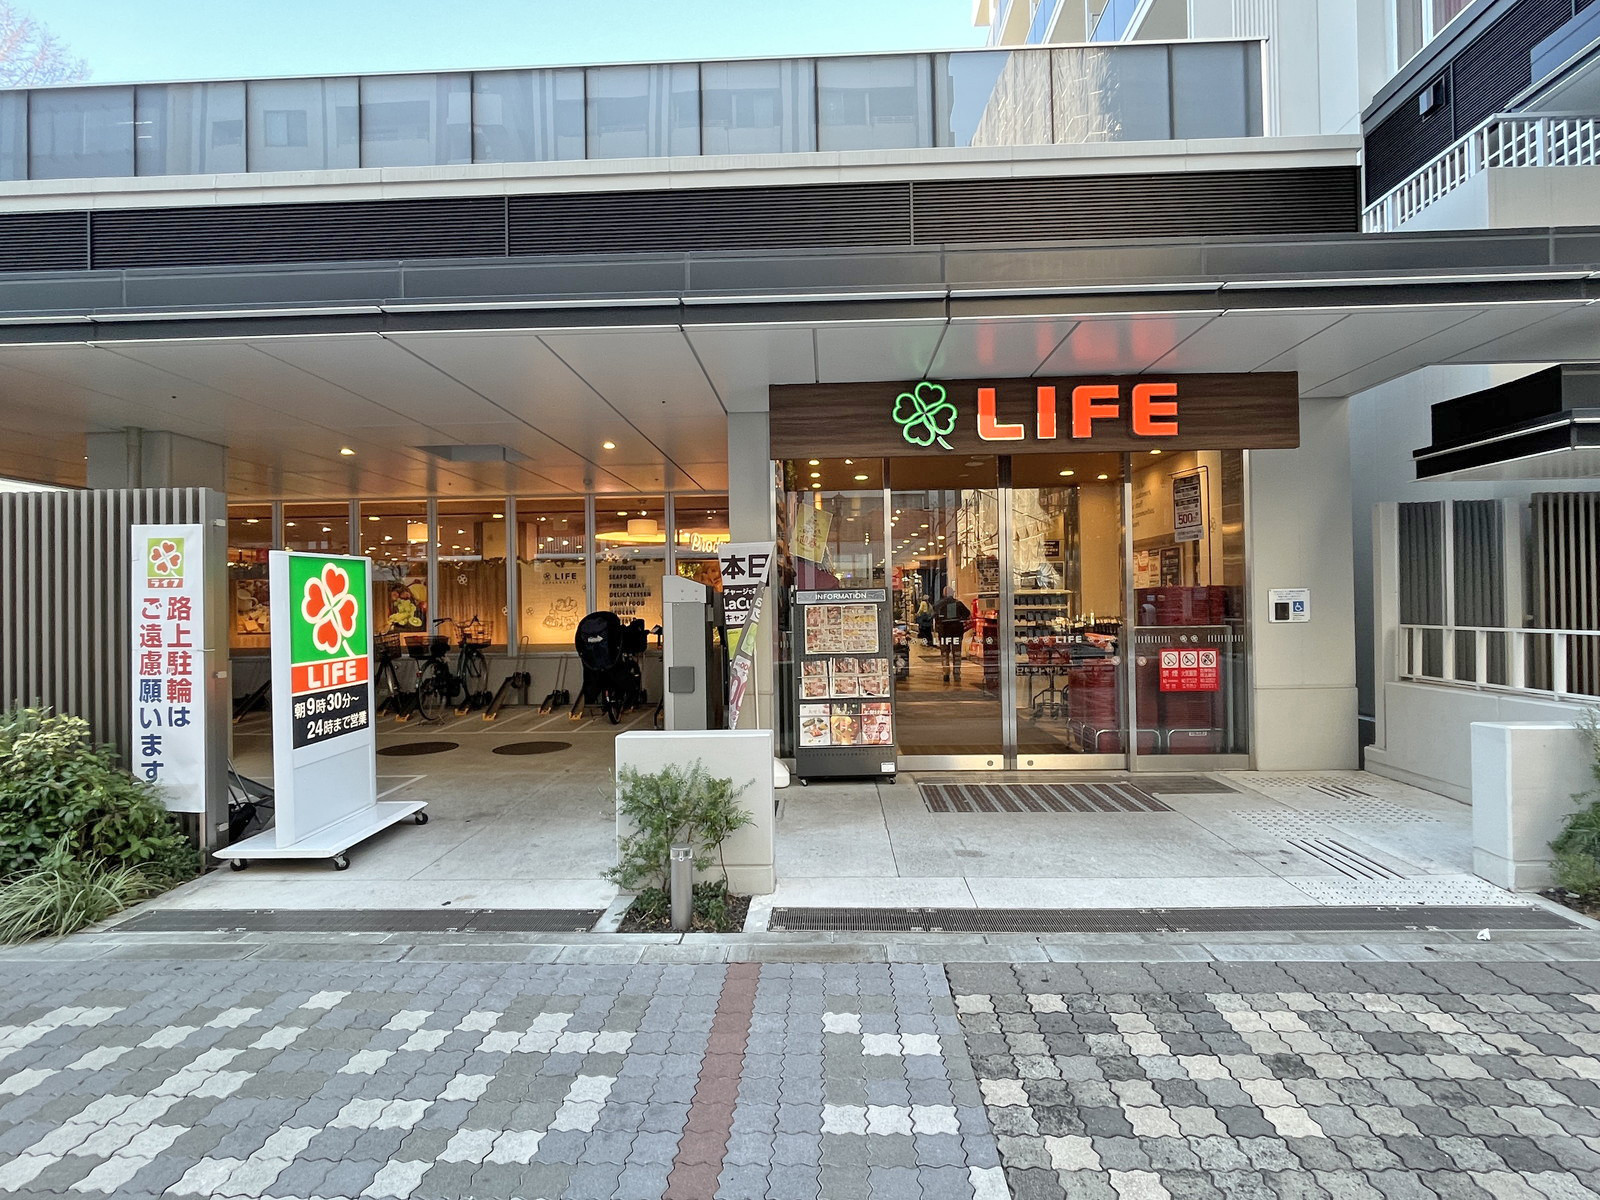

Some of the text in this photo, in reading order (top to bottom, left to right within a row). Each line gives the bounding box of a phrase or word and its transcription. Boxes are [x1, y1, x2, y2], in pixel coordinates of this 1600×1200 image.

[977, 383, 1178, 441] LIFE
[1178, 513, 1193, 524] 500
[721, 554, 770, 579] 本日
[150, 579, 180, 588] ライフ
[554, 572, 577, 580] LIFE
[815, 592, 867, 600] INFORMATION
[933, 637, 960, 645] LIFE
[1056, 635, 1082, 644] LIFE
[166, 596, 192, 727] 路上駐輪は
[307, 660, 357, 689] LIFE
[139, 597, 164, 784] ご遠慮願います
[306, 710, 367, 740] 24時まで営業
